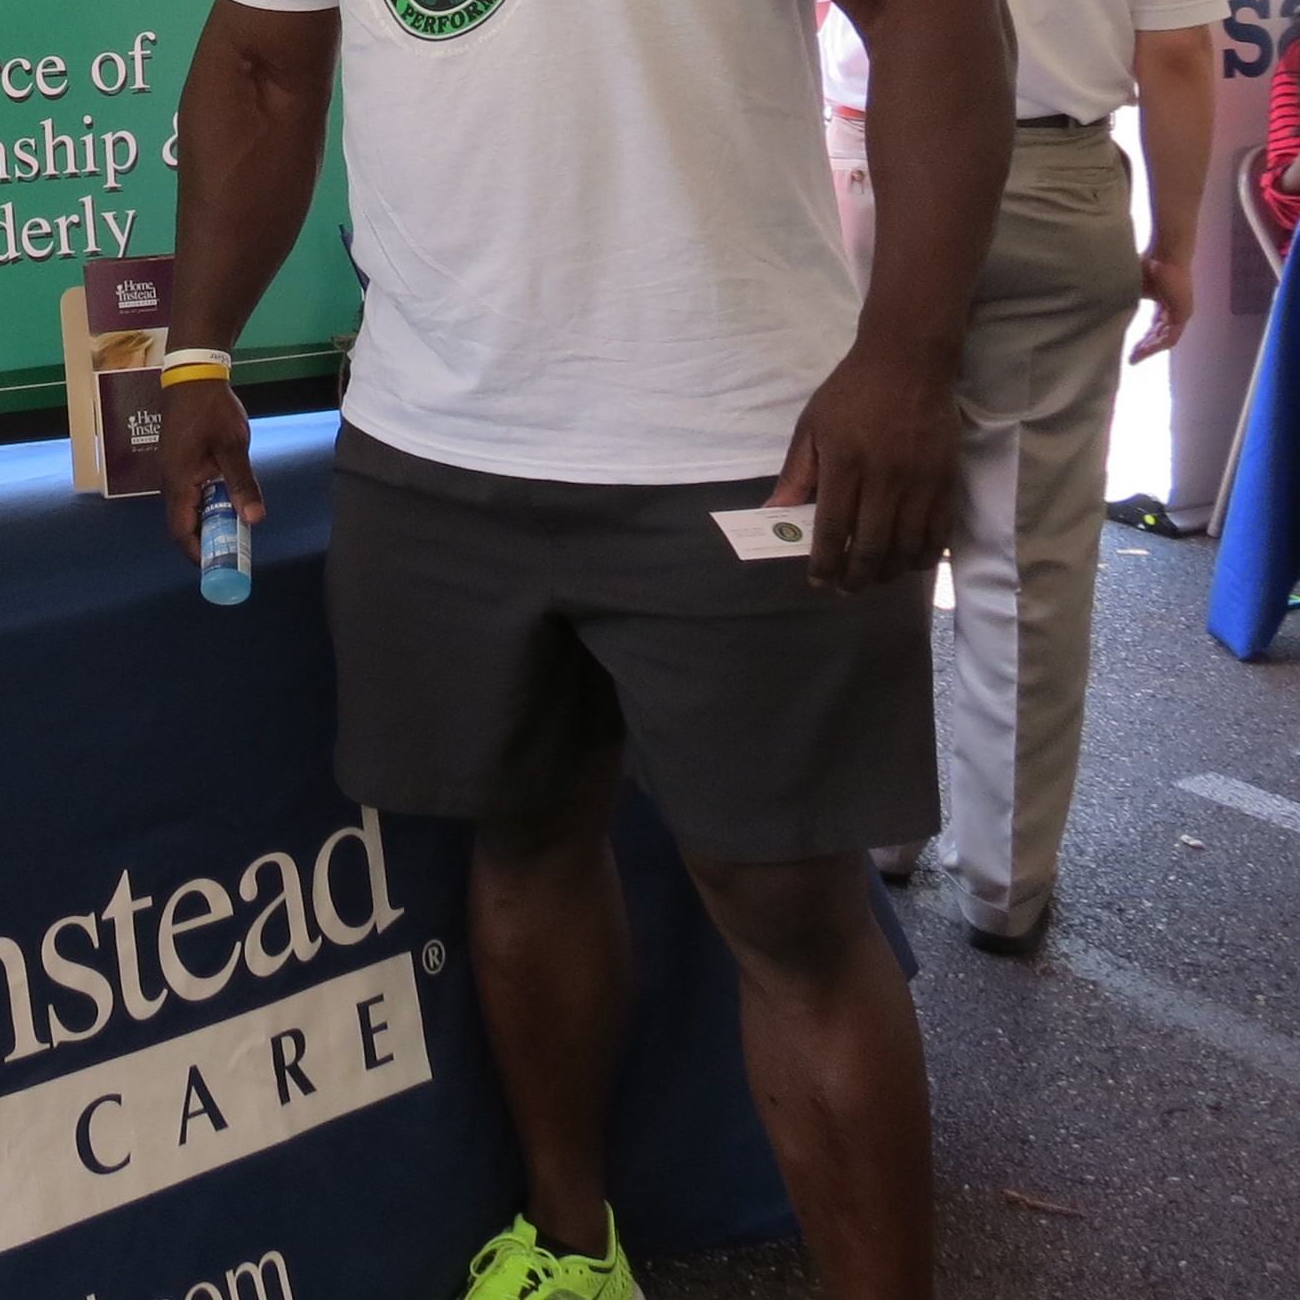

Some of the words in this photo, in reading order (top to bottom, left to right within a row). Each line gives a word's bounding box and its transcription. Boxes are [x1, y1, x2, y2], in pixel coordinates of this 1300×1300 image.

[91, 31, 157, 93] of
[124, 280, 154, 292] Home
[118, 286, 157, 302] Instead
[137, 410, 162, 425] Hom
[130, 422, 161, 437] Inste
[74, 994, 395, 1176] CARE
